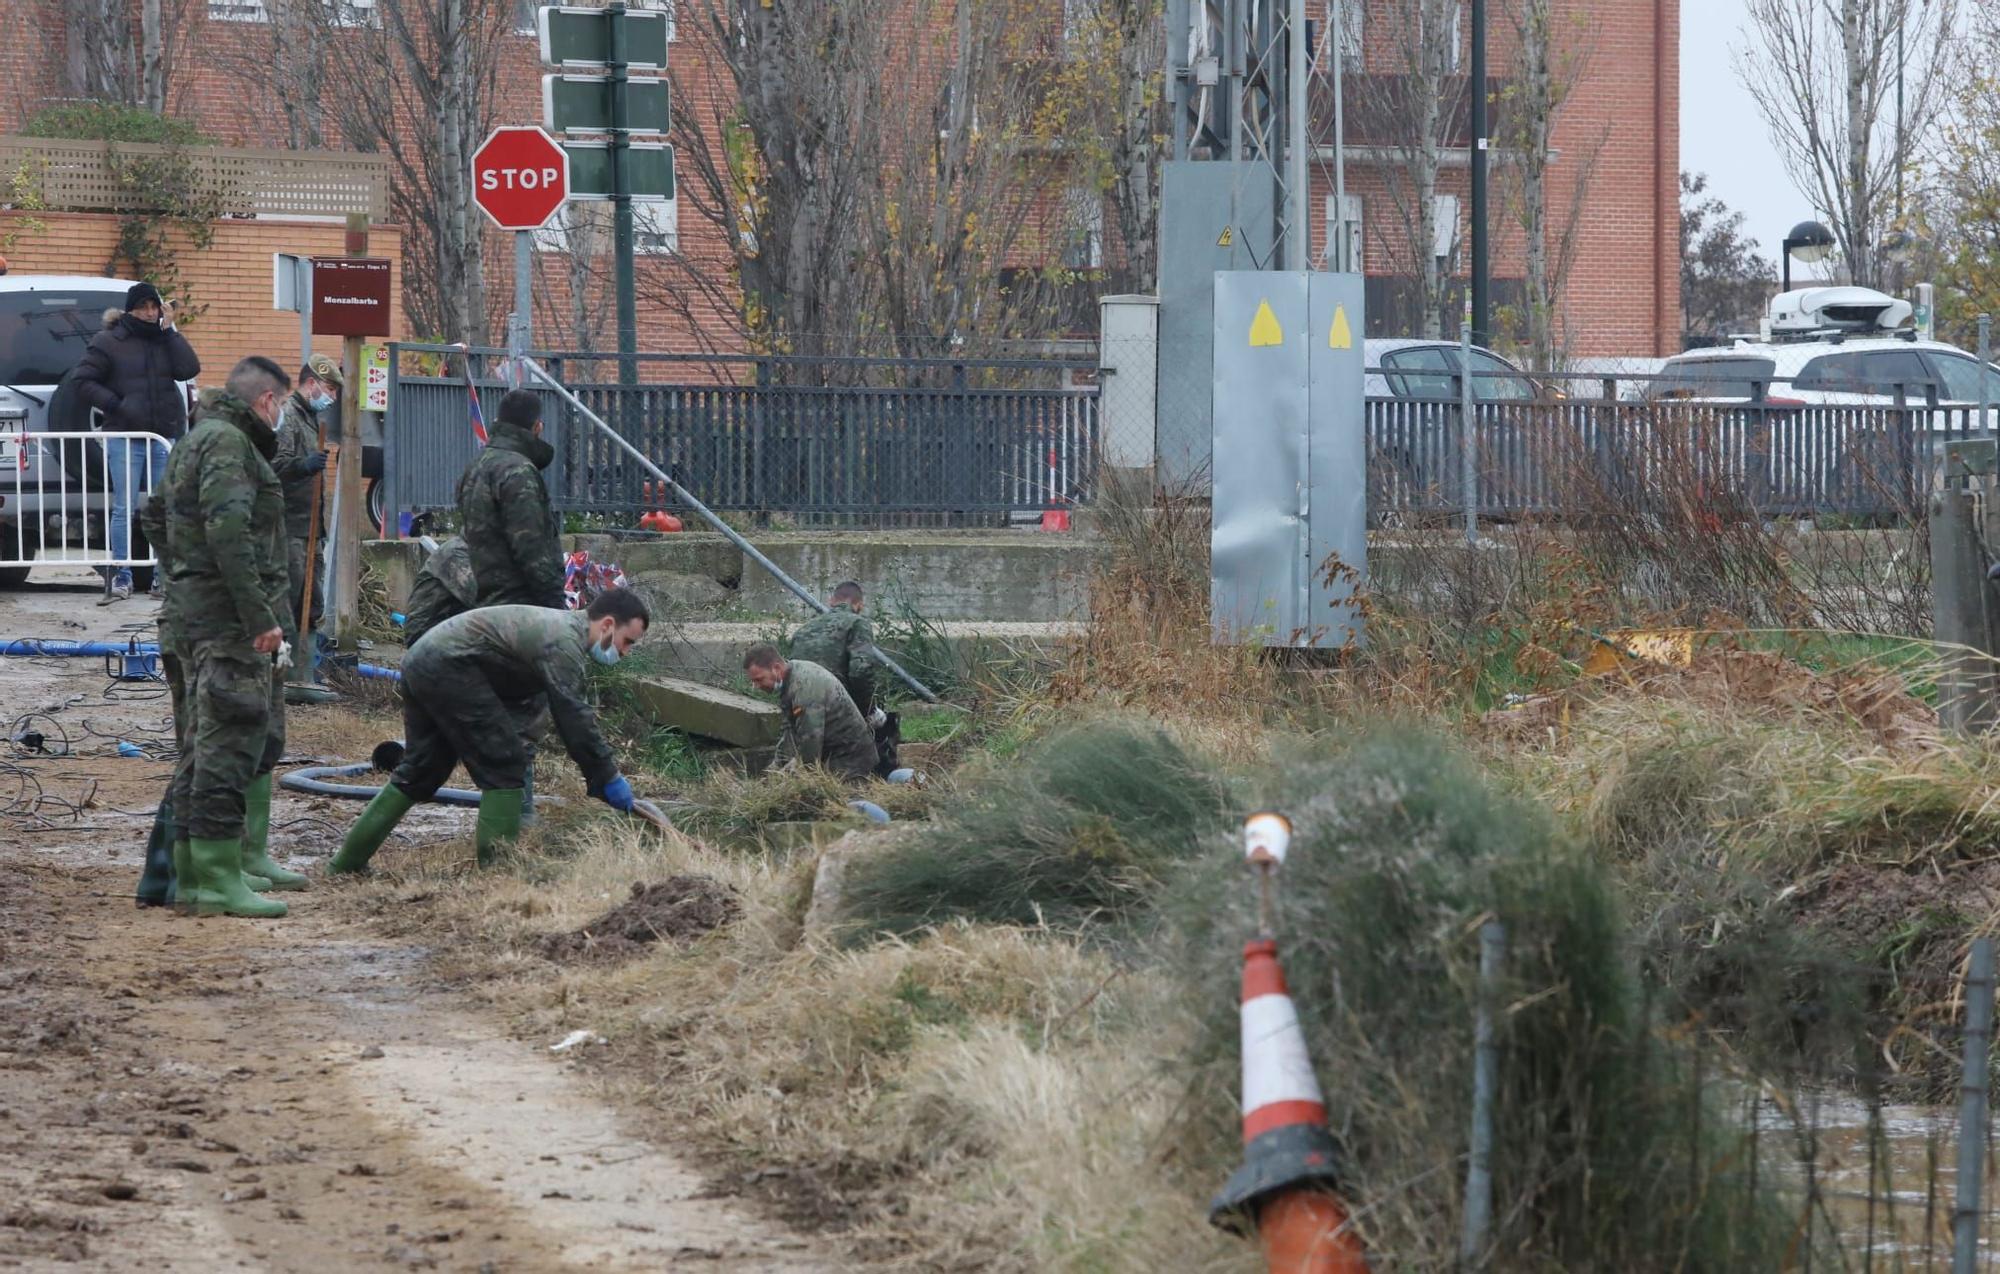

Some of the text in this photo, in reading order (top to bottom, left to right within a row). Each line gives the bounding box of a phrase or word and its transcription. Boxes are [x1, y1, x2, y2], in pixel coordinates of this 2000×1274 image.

[482, 168, 558, 190] STOP
[324, 296, 378, 305] Monzalbarba
[377, 350, 388, 358] 95
